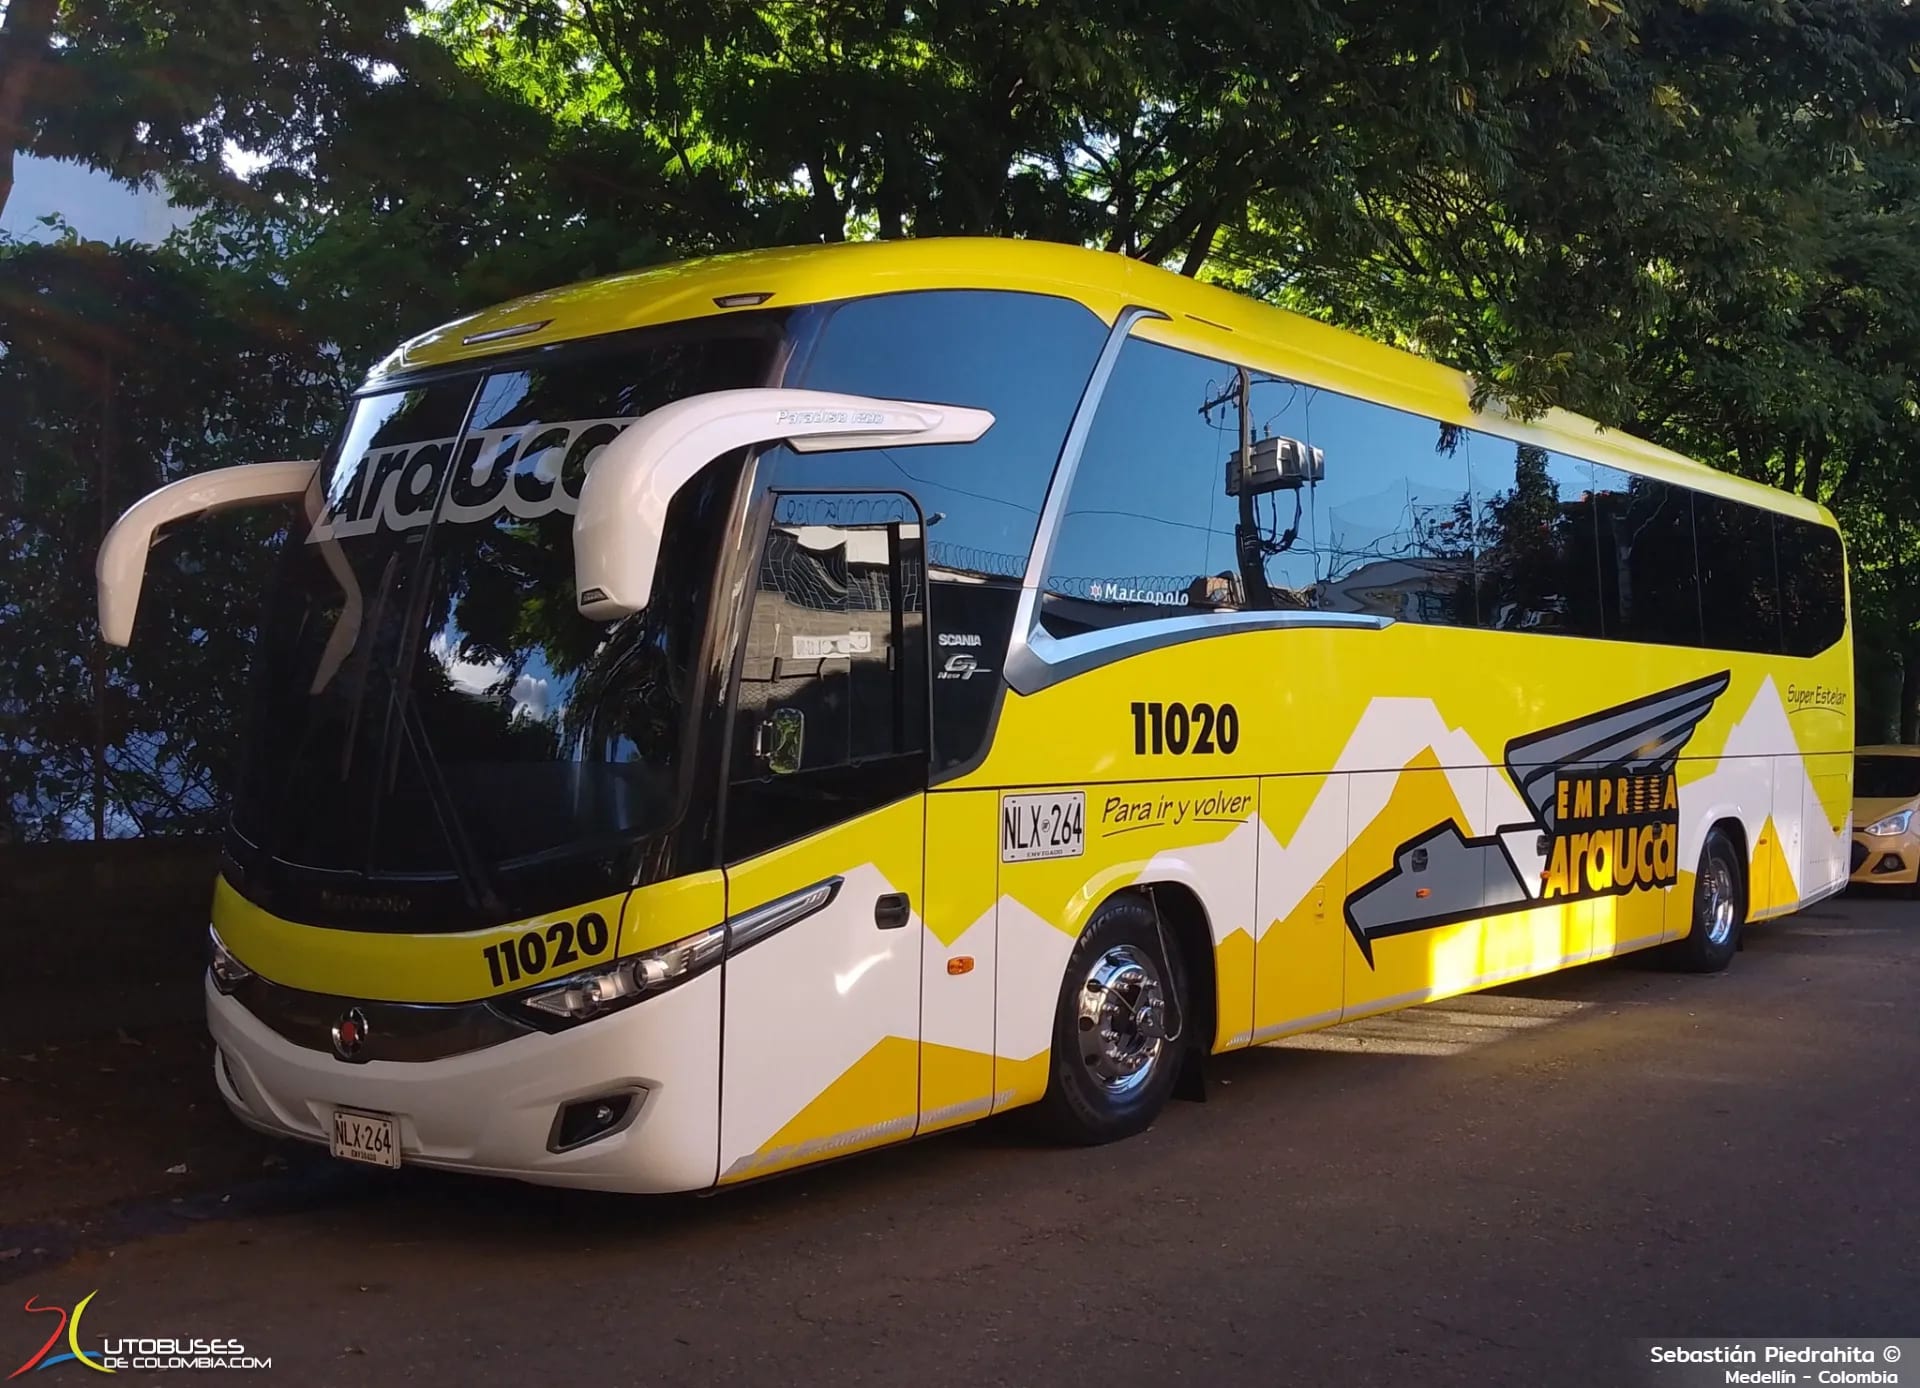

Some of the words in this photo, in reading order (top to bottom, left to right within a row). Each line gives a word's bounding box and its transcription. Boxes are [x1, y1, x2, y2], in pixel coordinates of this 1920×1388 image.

[776, 409, 848, 425] Paradiso
[1104, 582, 1189, 606] Marcopolo
[938, 633, 982, 647] SCANIA
[1787, 684, 1815, 710] Super
[1815, 686, 1847, 706] Estelar
[1130, 701, 1239, 756] 11020
[1101, 796, 1152, 824] Para
[1156, 794, 1173, 819] ir
[1173, 799, 1189, 825] y
[1194, 789, 1252, 816] volver
[1543, 822, 1677, 899] Arauca
[483, 911, 609, 989] 11020
